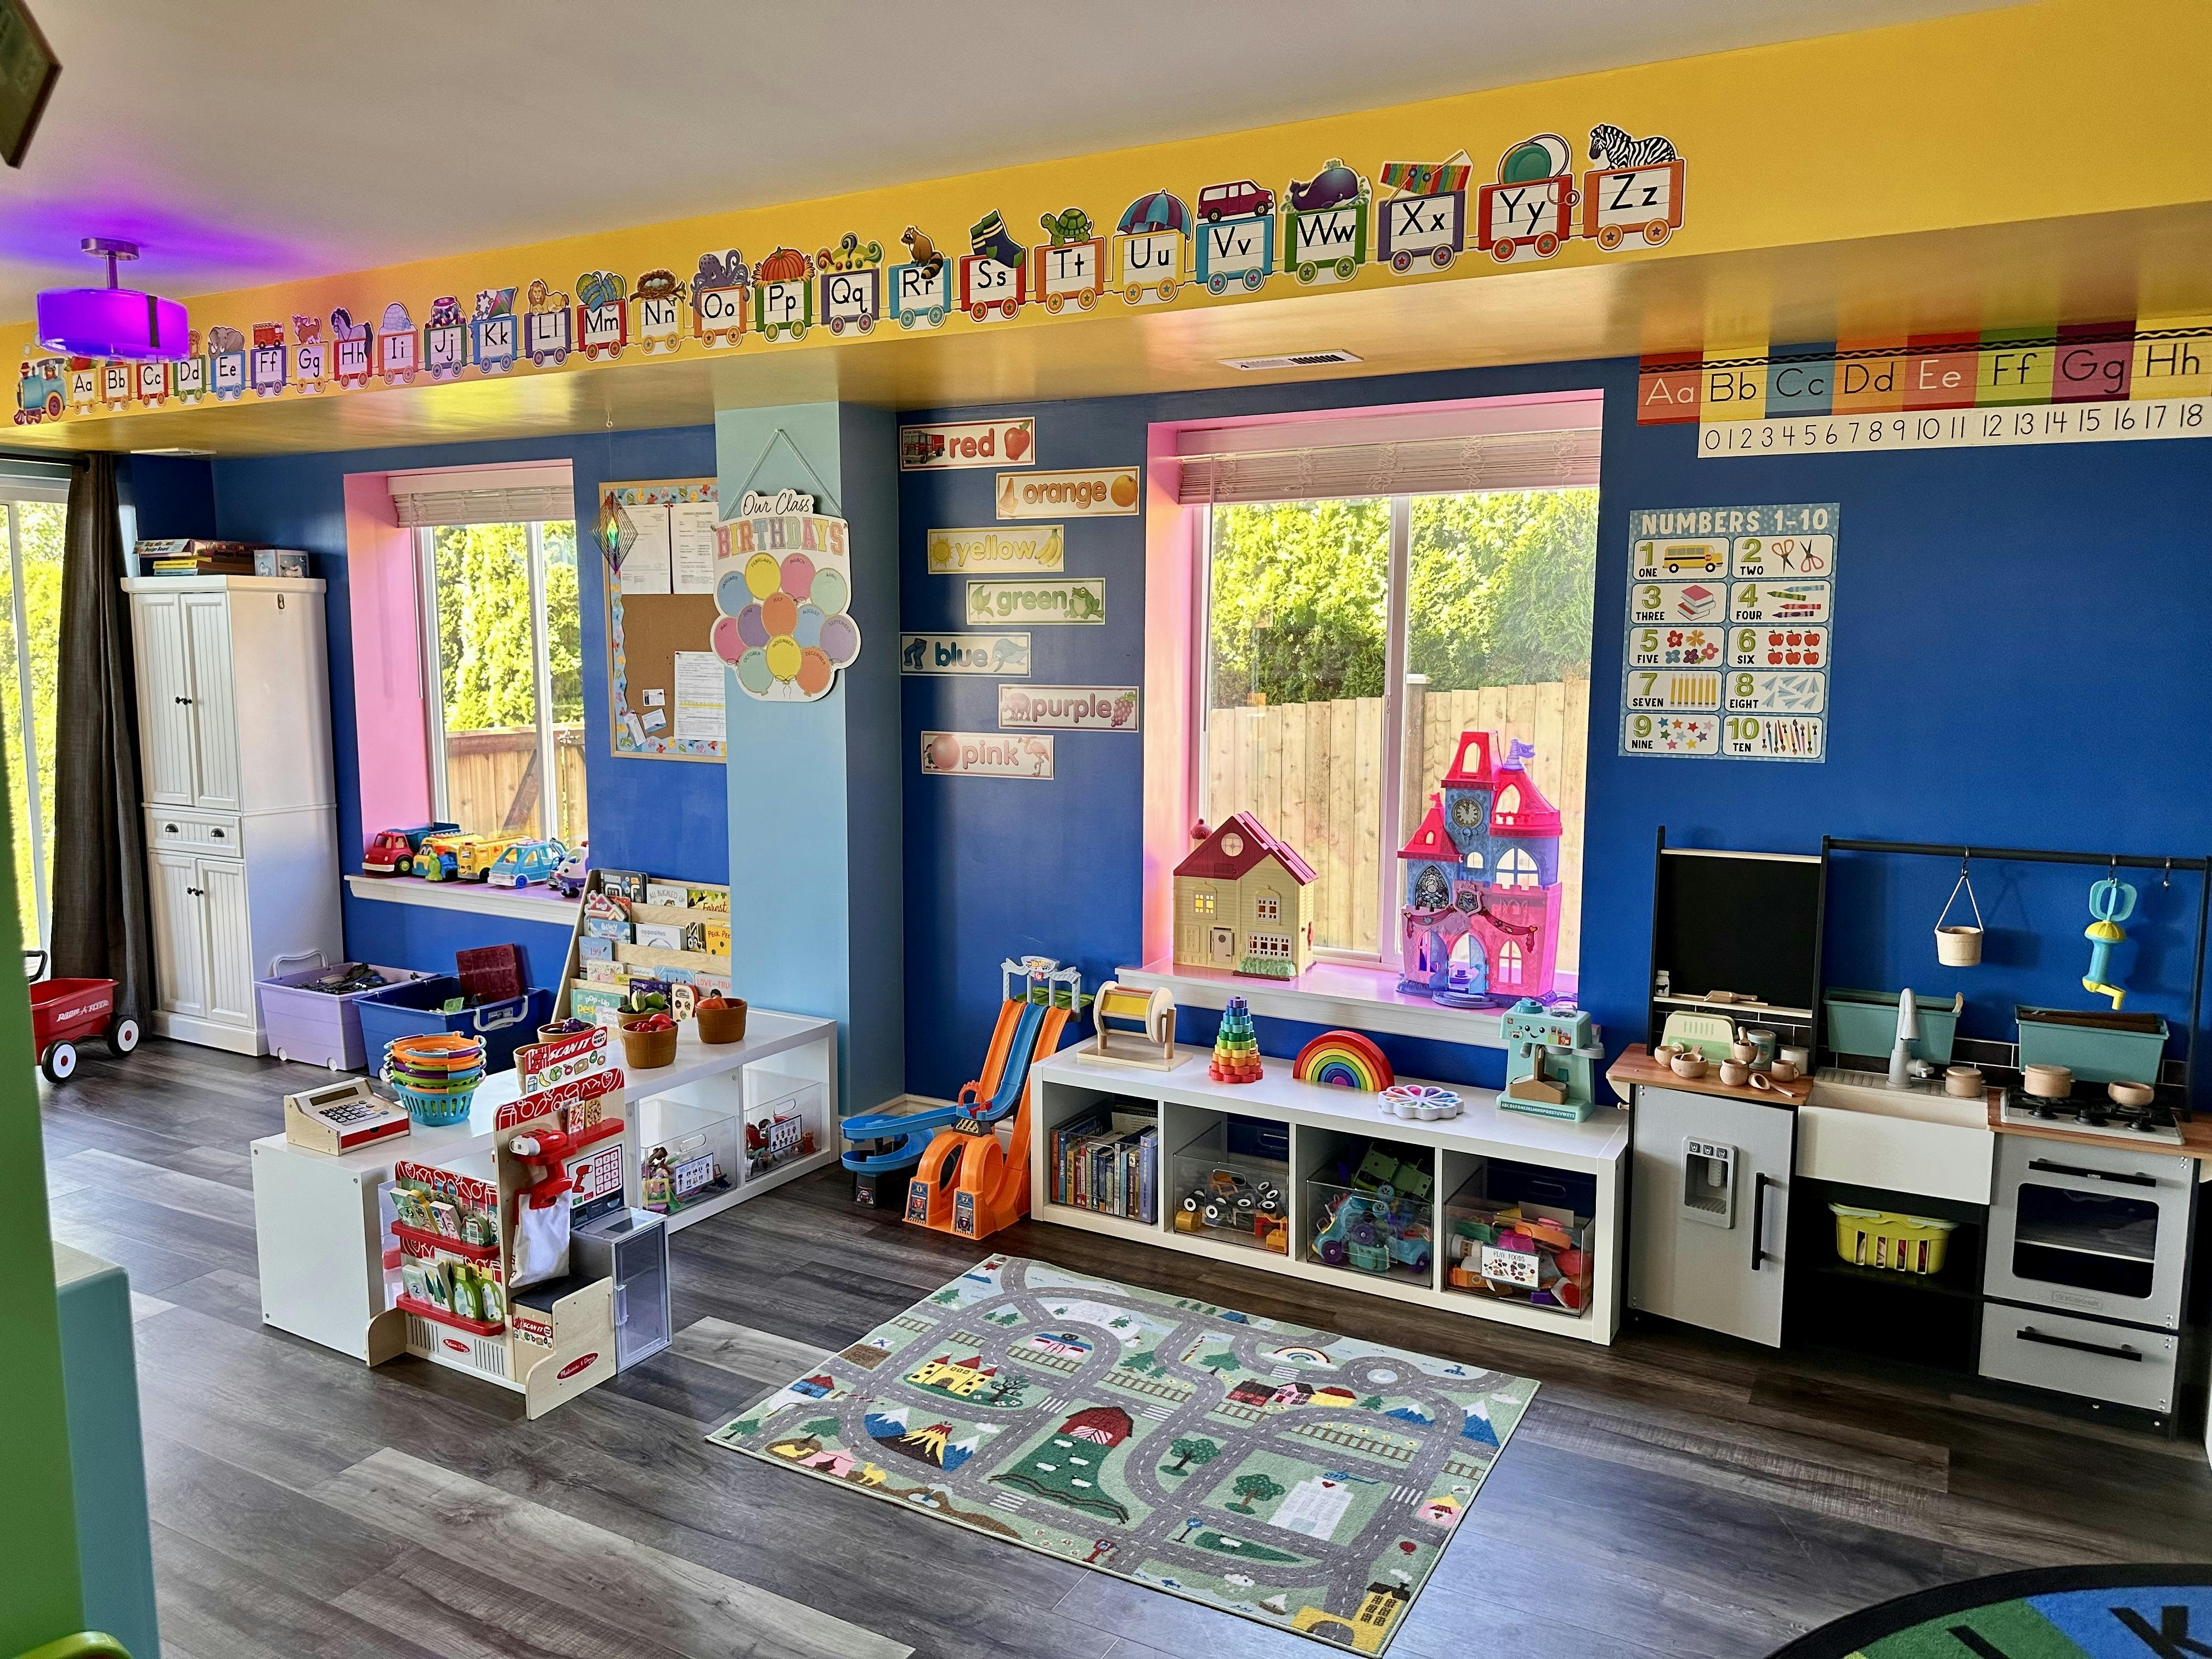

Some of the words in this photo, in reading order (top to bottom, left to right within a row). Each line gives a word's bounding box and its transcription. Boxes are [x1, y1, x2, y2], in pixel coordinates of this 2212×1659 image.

[74, 376, 93, 394] Aa
[108, 367, 125, 388] Bb
[143, 367, 161, 386] Cc
[180, 360, 199, 381] Dd
[221, 357, 236, 376] Ee
[261, 351, 276, 369] Ff
[300, 349, 320, 378] Gg
[342, 342, 364, 364] Hh
[392, 337, 404, 359] Ii
[435, 330, 454, 362] Jj
[485, 324, 508, 346] Kk
[540, 315, 557, 338] Ll
[585, 309, 619, 332] Mm
[646, 300, 674, 325] Nn
[704, 294, 735, 319] Oo
[770, 285, 796, 319] Pp
[832, 280, 867, 313] Qq
[904, 270, 933, 297] Rr
[978, 262, 1006, 288] Ss
[1058, 250, 1084, 278] Tt
[1131, 240, 1169, 268] Uu
[1214, 228, 1251, 258] Vv
[1297, 216, 1356, 247] Ww
[1400, 201, 1445, 235] Xx
[1500, 190, 1545, 234] Yy
[1610, 174, 1657, 210] Zz
[1646, 377, 1694, 405] Aa
[1711, 372, 1757, 402] Bb
[1776, 369, 1825, 397] Cc
[1845, 363, 1894, 393] Dd
[1919, 359, 1962, 390] Ee
[1994, 352, 2030, 385] Ff
[2062, 349, 2124, 393] Gg
[2147, 344, 2199, 377] Hh
[1706, 430, 1719, 449] 0
[1728, 430, 1733, 449] 1
[1740, 428, 1752, 448] 2
[1762, 428, 1773, 447] 3
[1782, 427, 1795, 446] 4
[1804, 426, 1817, 444] 5
[1826, 425, 1837, 444] 6
[1849, 423, 1860, 443] 7
[1869, 422, 1882, 442] 8
[1893, 421, 1905, 441] 9
[1918, 419, 1939, 439] 10
[1951, 417, 1965, 437] 11
[1983, 416, 2001, 436] 12
[2015, 414, 2033, 435] 13
[2046, 412, 2067, 432] 14
[2081, 410, 2100, 430] 15
[2114, 408, 2134, 428] 16
[2147, 406, 2166, 427] 17
[2181, 405, 2202, 426] 18
[949, 428, 994, 459] red
[743, 495, 771, 515] Our
[776, 493, 809, 515] Class
[1023, 481, 1107, 509] orange
[1642, 511, 1760, 534] NUMBERS
[1774, 509, 1828, 531] 1-10
[716, 517, 844, 560] BIRTHDAYS
[751, 557, 772, 567] FEBRUARY
[955, 535, 1036, 567] yellow
[1640, 542, 1654, 566] 1
[1741, 539, 1762, 562] 2
[722, 575, 738, 589] JANUARY
[826, 573, 837, 581] APRIL
[1639, 568, 1657, 577] ONE
[1740, 566, 1763, 575] TWO
[996, 588, 1067, 616] green
[1642, 585, 1661, 609] 3
[1738, 584, 1758, 607] 4
[743, 608, 753, 617] JUNE
[1636, 612, 1664, 620] THREE
[1736, 611, 1762, 620] FOUR
[828, 619, 851, 633] SEPTEMBER
[772, 639, 794, 648] NOVEMBER
[1640, 629, 1658, 652] 5
[1737, 629, 1756, 652] 6
[743, 651, 760, 663] OCTOBER
[805, 650, 826, 665] DECEMBER
[934, 642, 988, 667] blue
[1638, 655, 1658, 664] FIVE
[1737, 655, 1754, 664] SIX
[1639, 673, 1658, 696] 7
[1735, 673, 1754, 697] 8
[1031, 693, 1111, 723] purple
[1633, 698, 1663, 707] SEVEN
[1730, 699, 1758, 708] EIGHT
[1633, 716, 1651, 738] 9
[1726, 717, 1759, 740] 10
[962, 741, 1019, 769] pink
[1632, 740, 1653, 749] NINE
[1733, 743, 1751, 752] TEN
[549, 1042, 578, 1061] SCAN
[577, 1037, 591, 1051] IT
[1493, 1250, 1505, 1259] PLAY
[1509, 1252, 1525, 1262] FOODS
